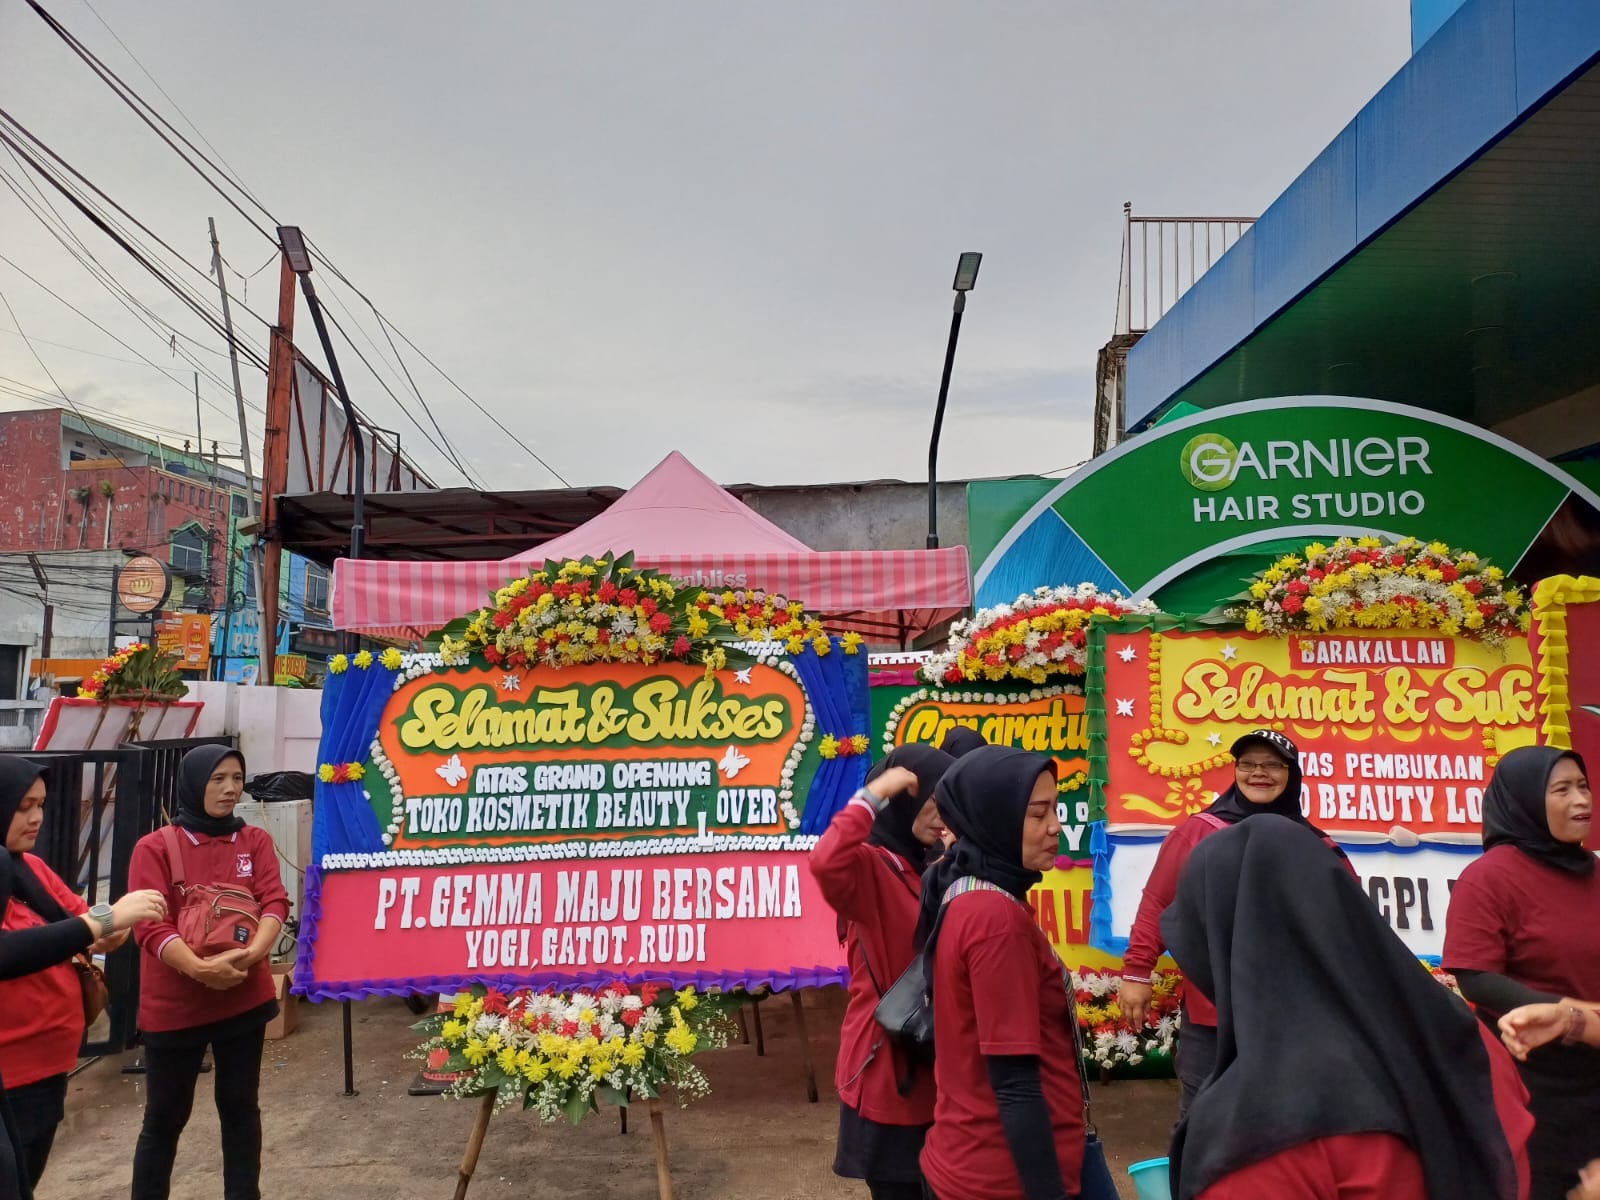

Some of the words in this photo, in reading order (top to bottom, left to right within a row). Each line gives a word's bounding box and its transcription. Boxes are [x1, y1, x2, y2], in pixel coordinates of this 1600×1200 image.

[1193, 495, 1280, 522] HAIR
[1292, 490, 1425, 519] STUDIO
[1301, 639, 1446, 665] BARAKALLAH
[1177, 662, 1375, 723] Selamat
[1382, 667, 1430, 724] &
[400, 687, 586, 750] Selamat
[586, 686, 629, 743] &
[626, 679, 784, 742] Sukses
[475, 766, 529, 794] ATAS
[533, 763, 606, 791] GRAND
[613, 761, 711, 789] OPENING
[1346, 753, 1484, 781] PEMBUKAAN
[405, 797, 462, 834] TOKO
[465, 793, 591, 833] KOSMETIK
[595, 790, 691, 828] BEAUTY
[1318, 783, 1434, 822] BEAUTY
[1445, 786, 1487, 824] LO
[554, 868, 643, 923] MAJU
[652, 865, 802, 920] BERSAMA
